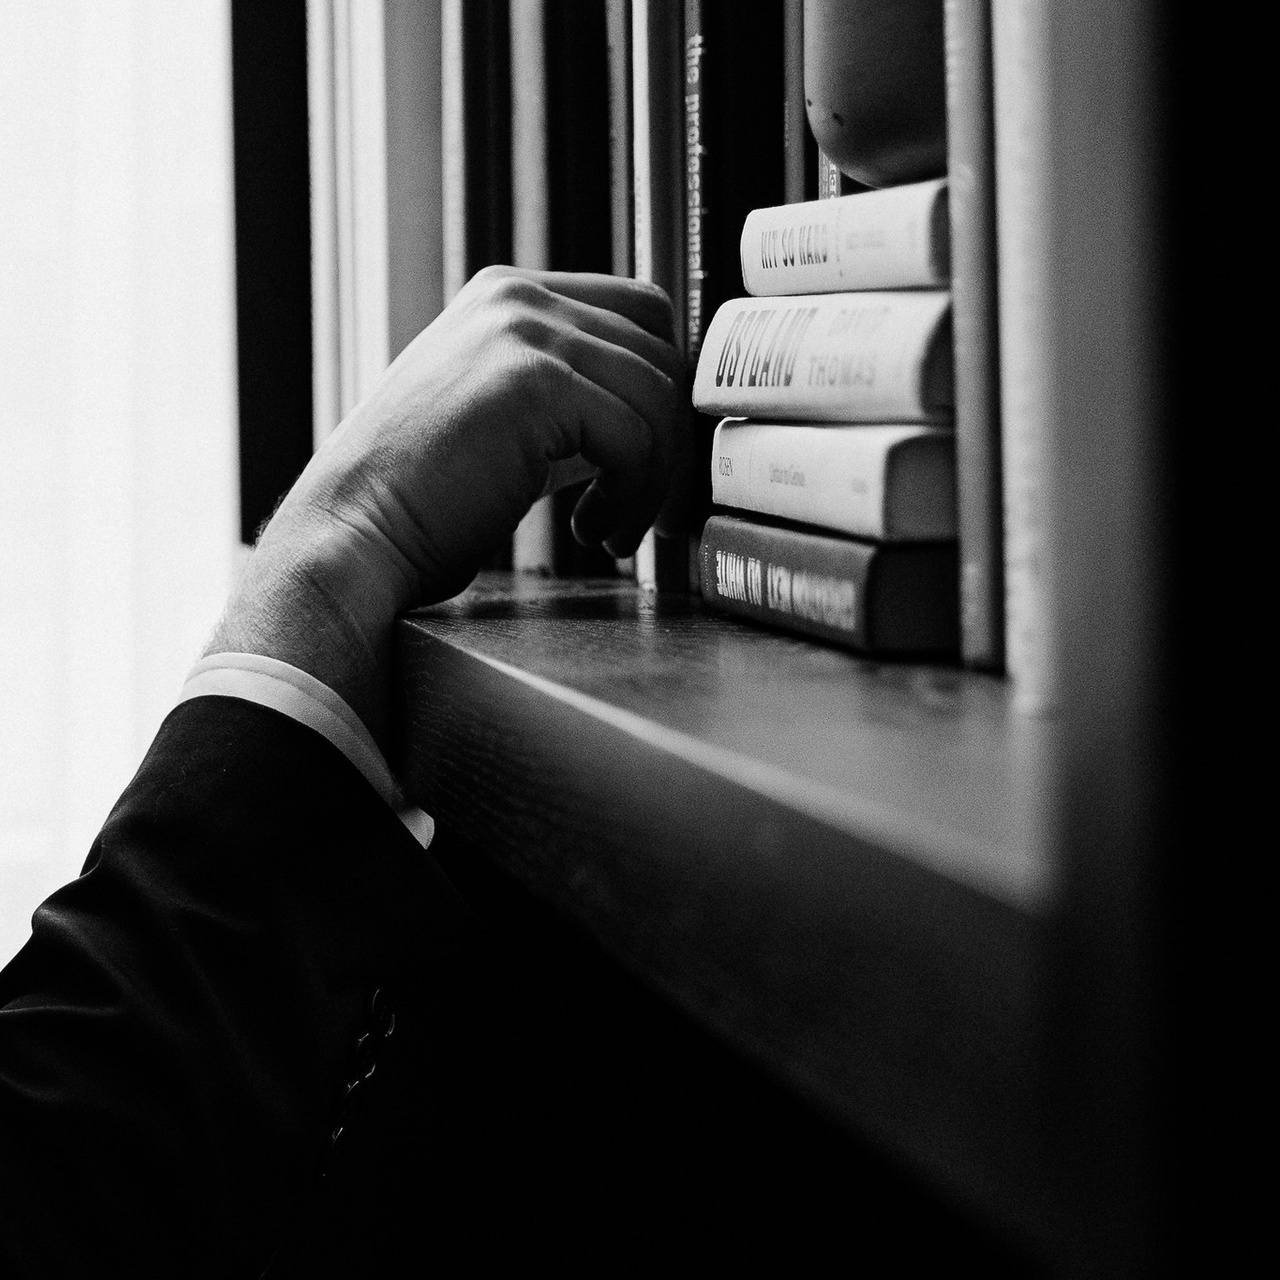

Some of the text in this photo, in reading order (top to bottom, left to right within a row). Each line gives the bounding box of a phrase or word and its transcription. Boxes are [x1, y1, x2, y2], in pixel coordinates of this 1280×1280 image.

[687, 33, 705, 83] the
[685, 93, 708, 280] professional
[761, 229, 777, 269] HIT
[782, 226, 795, 267] SO
